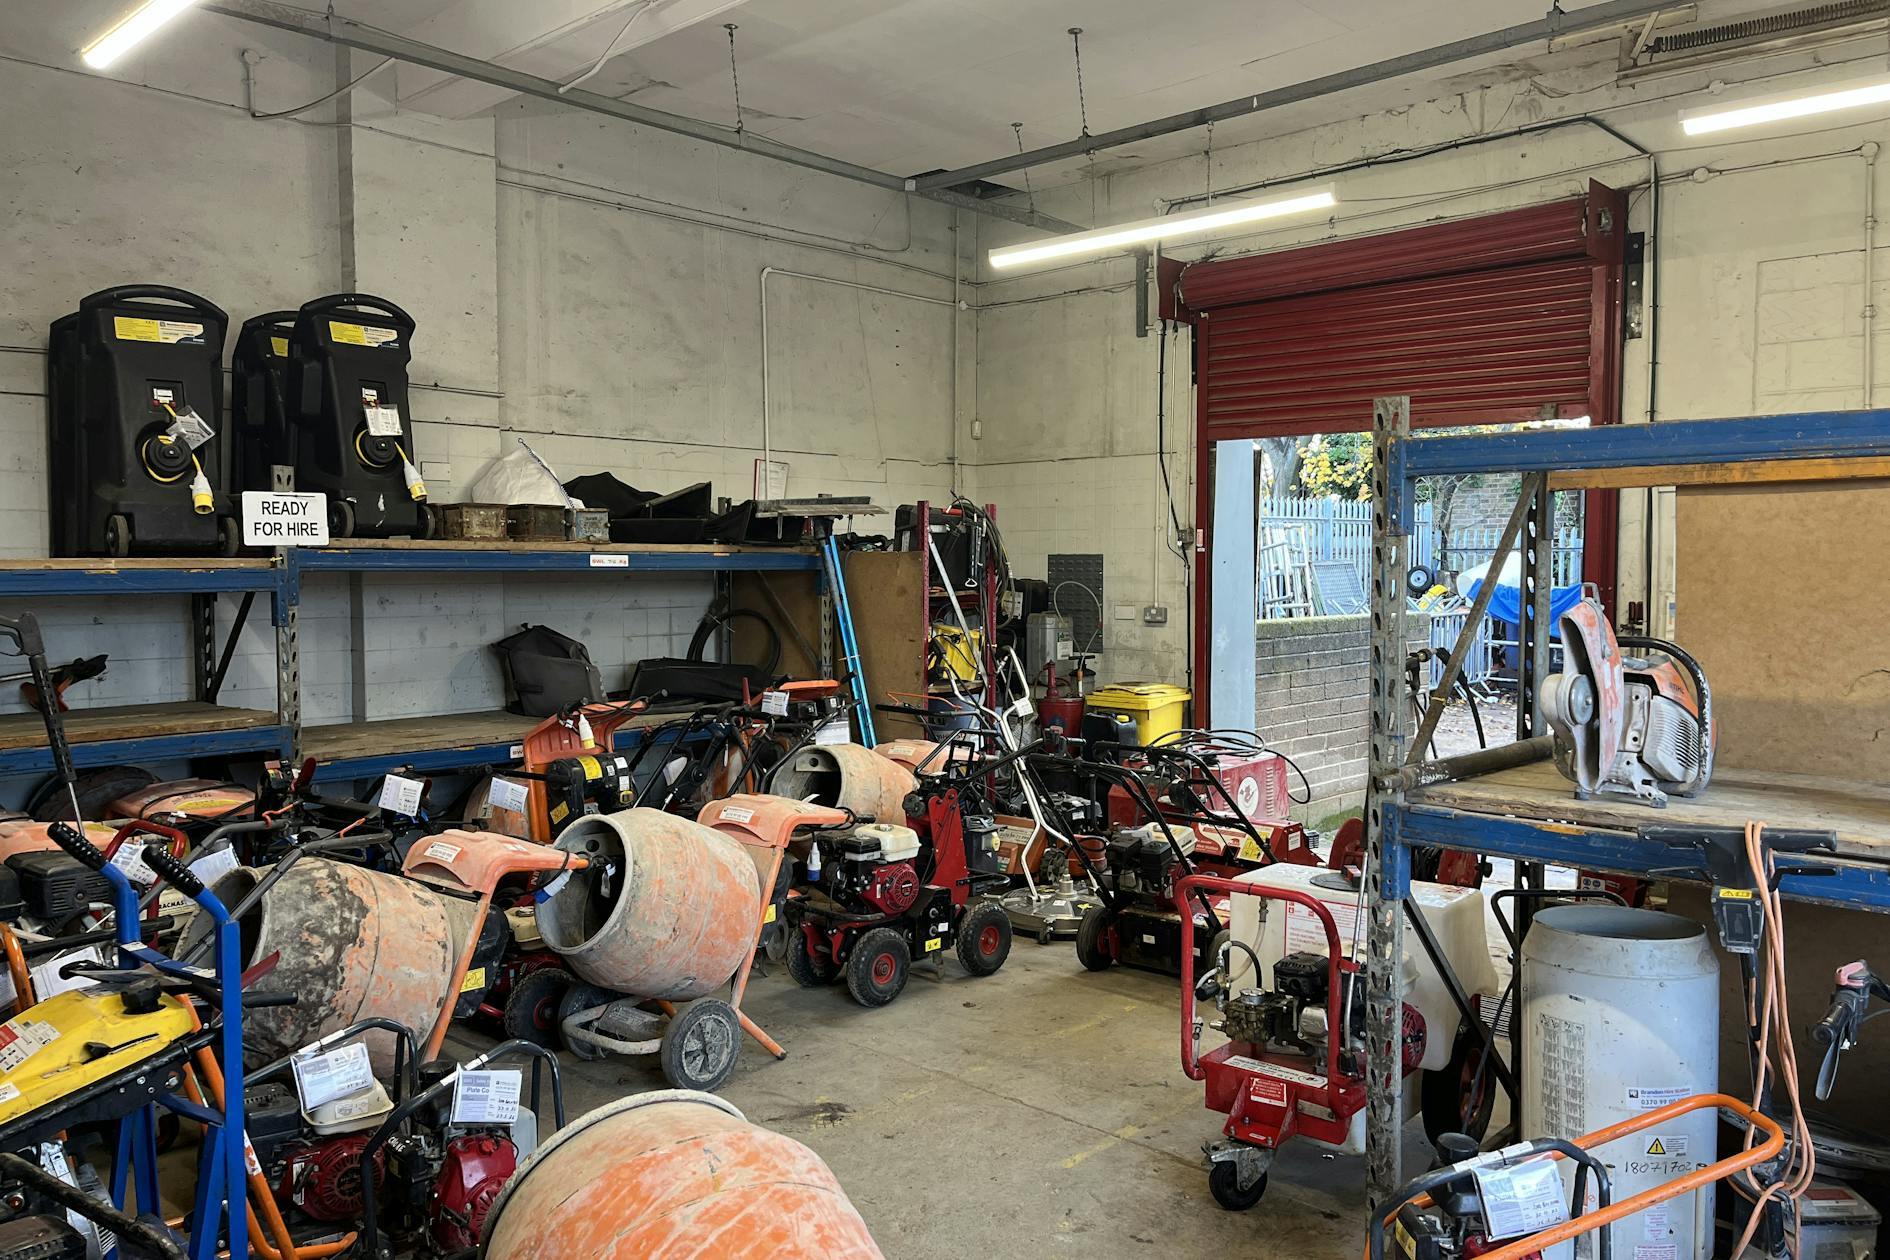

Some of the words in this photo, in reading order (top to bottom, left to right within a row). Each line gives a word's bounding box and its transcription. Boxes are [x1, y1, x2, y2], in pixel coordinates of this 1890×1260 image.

[261, 501, 309, 516] READY
[254, 522, 283, 536] FOR
[287, 522, 319, 536] HIRE
